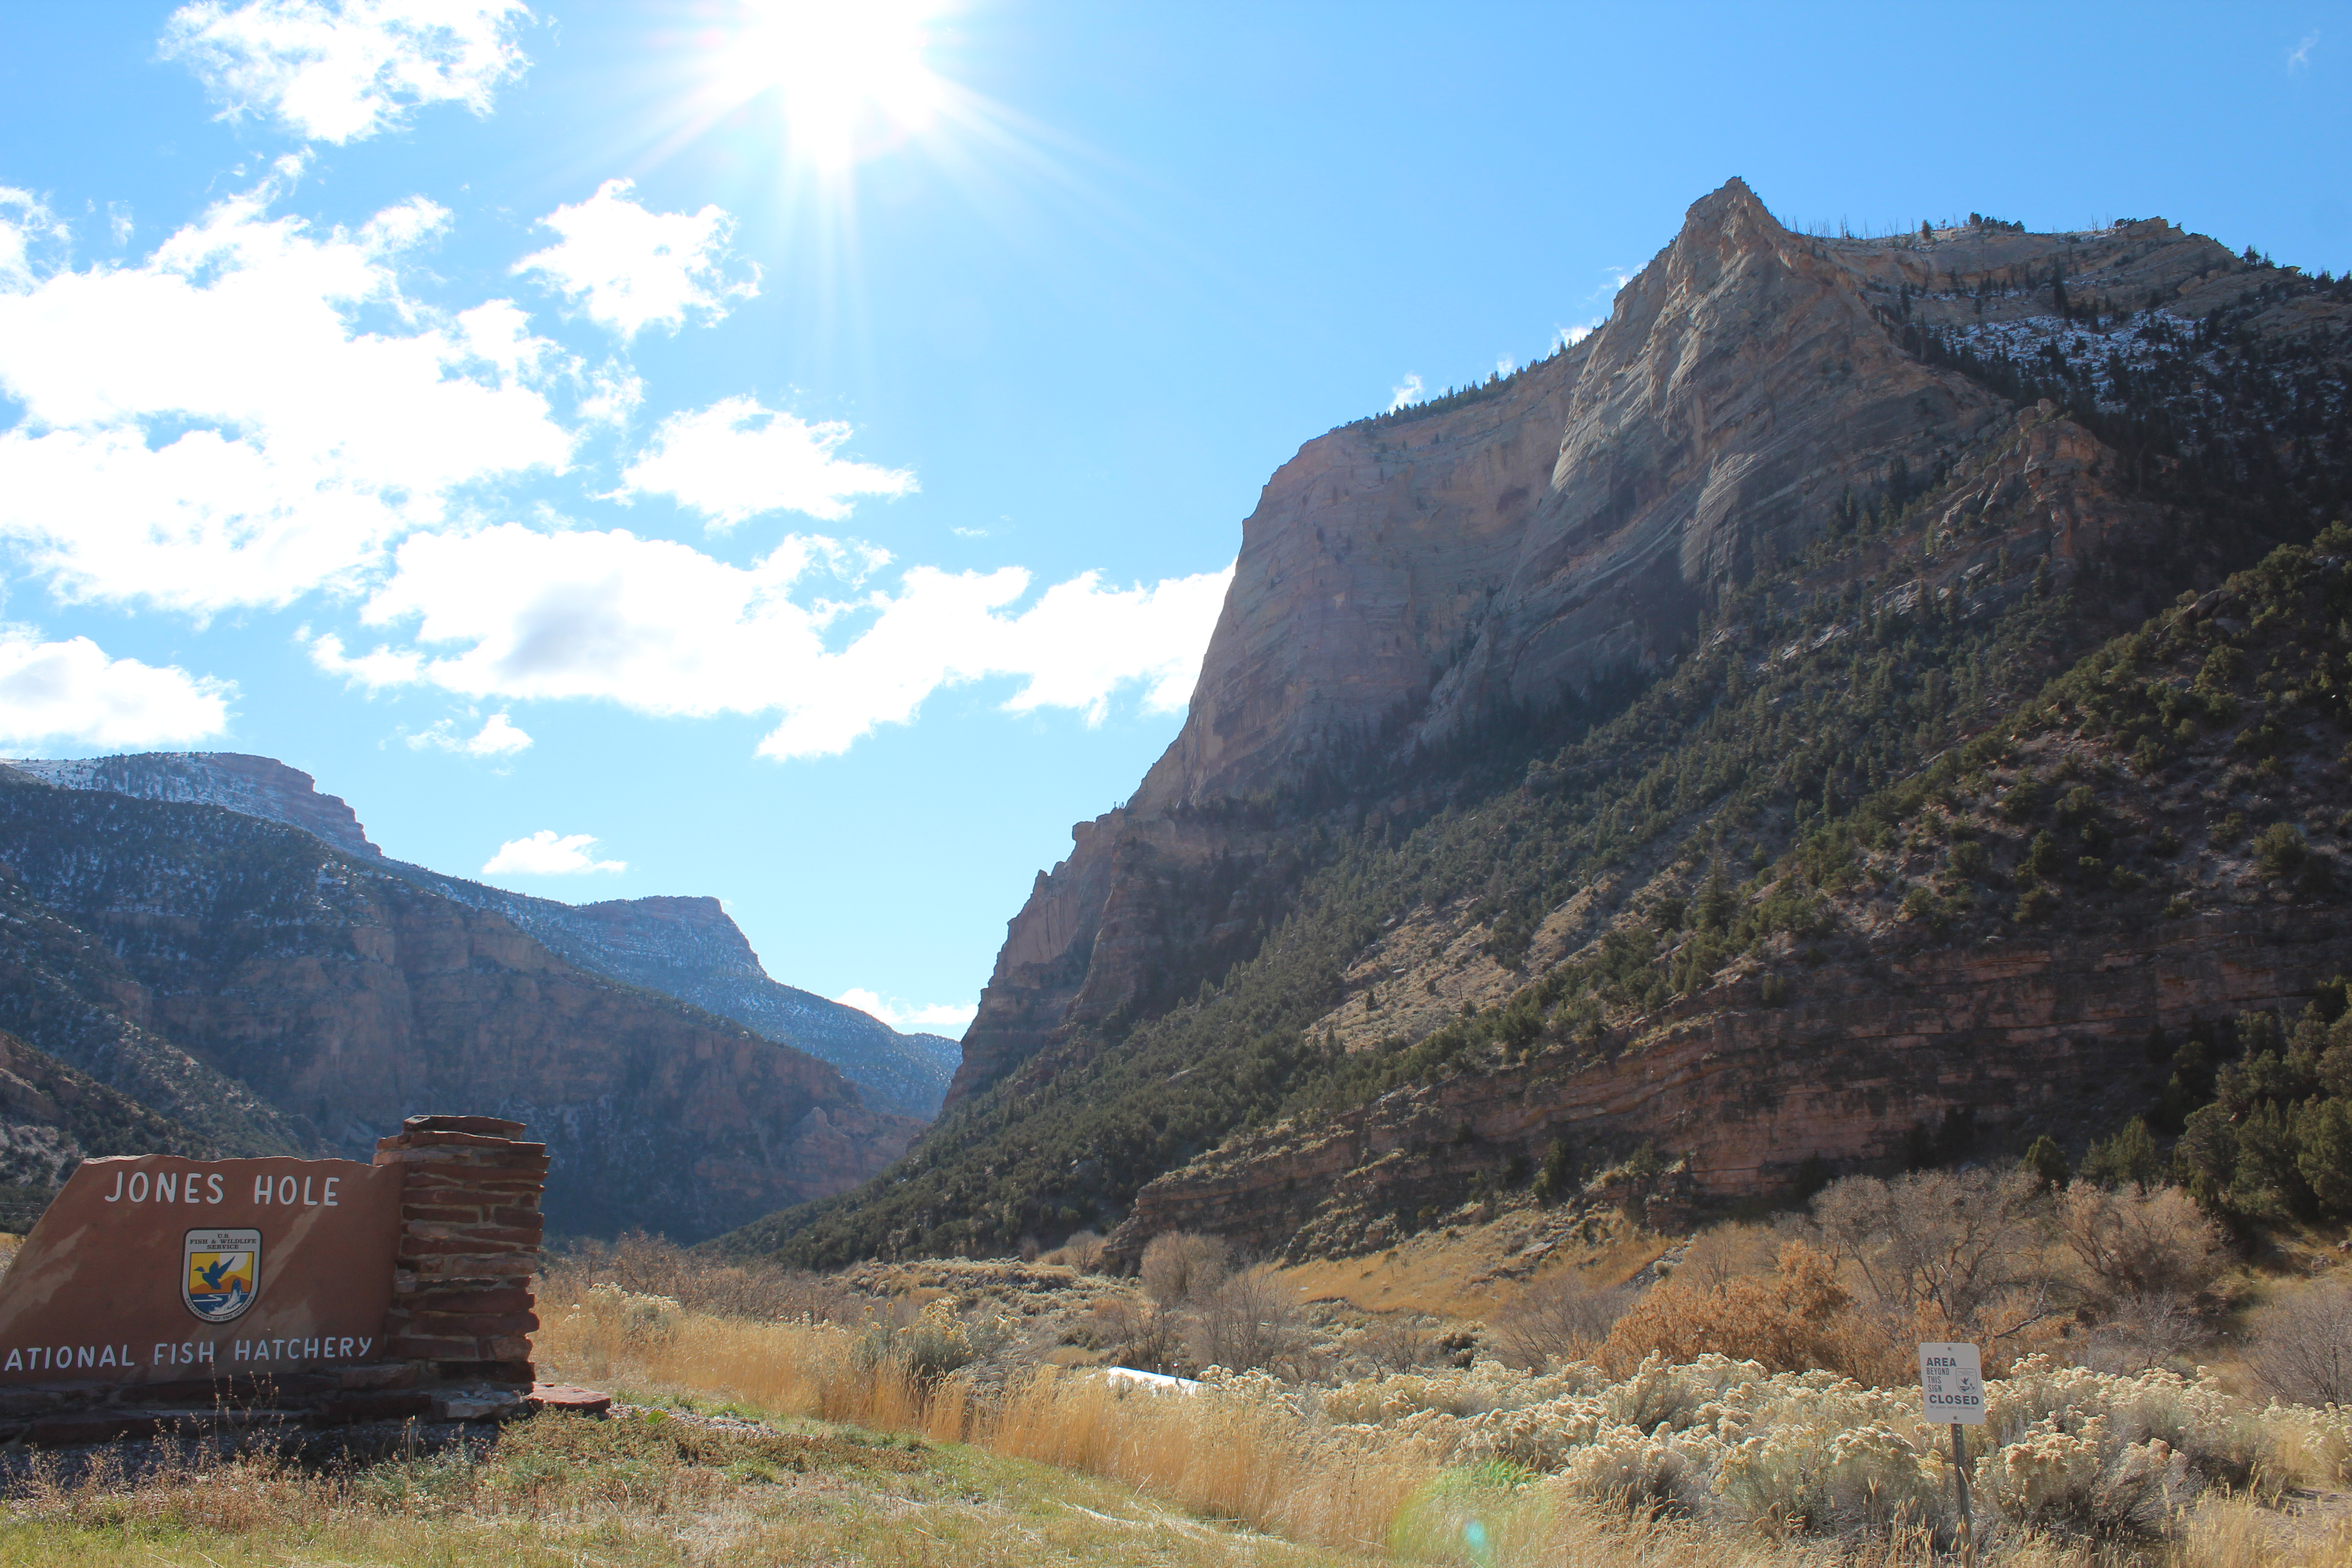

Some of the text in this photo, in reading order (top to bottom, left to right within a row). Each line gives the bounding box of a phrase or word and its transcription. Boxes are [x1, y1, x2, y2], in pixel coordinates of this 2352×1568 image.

[105, 1171, 340, 1206] JONES HOLE
[186, 1298, 212, 1319] DEPARTMENT
[235, 1296, 254, 1315] INTERIOR
[154, 1342, 214, 1365] FISH
[235, 1337, 372, 1361] HATCHERY
[1926, 1357, 1956, 1367] AREA
[1929, 1394, 1979, 1405] CLOSED
